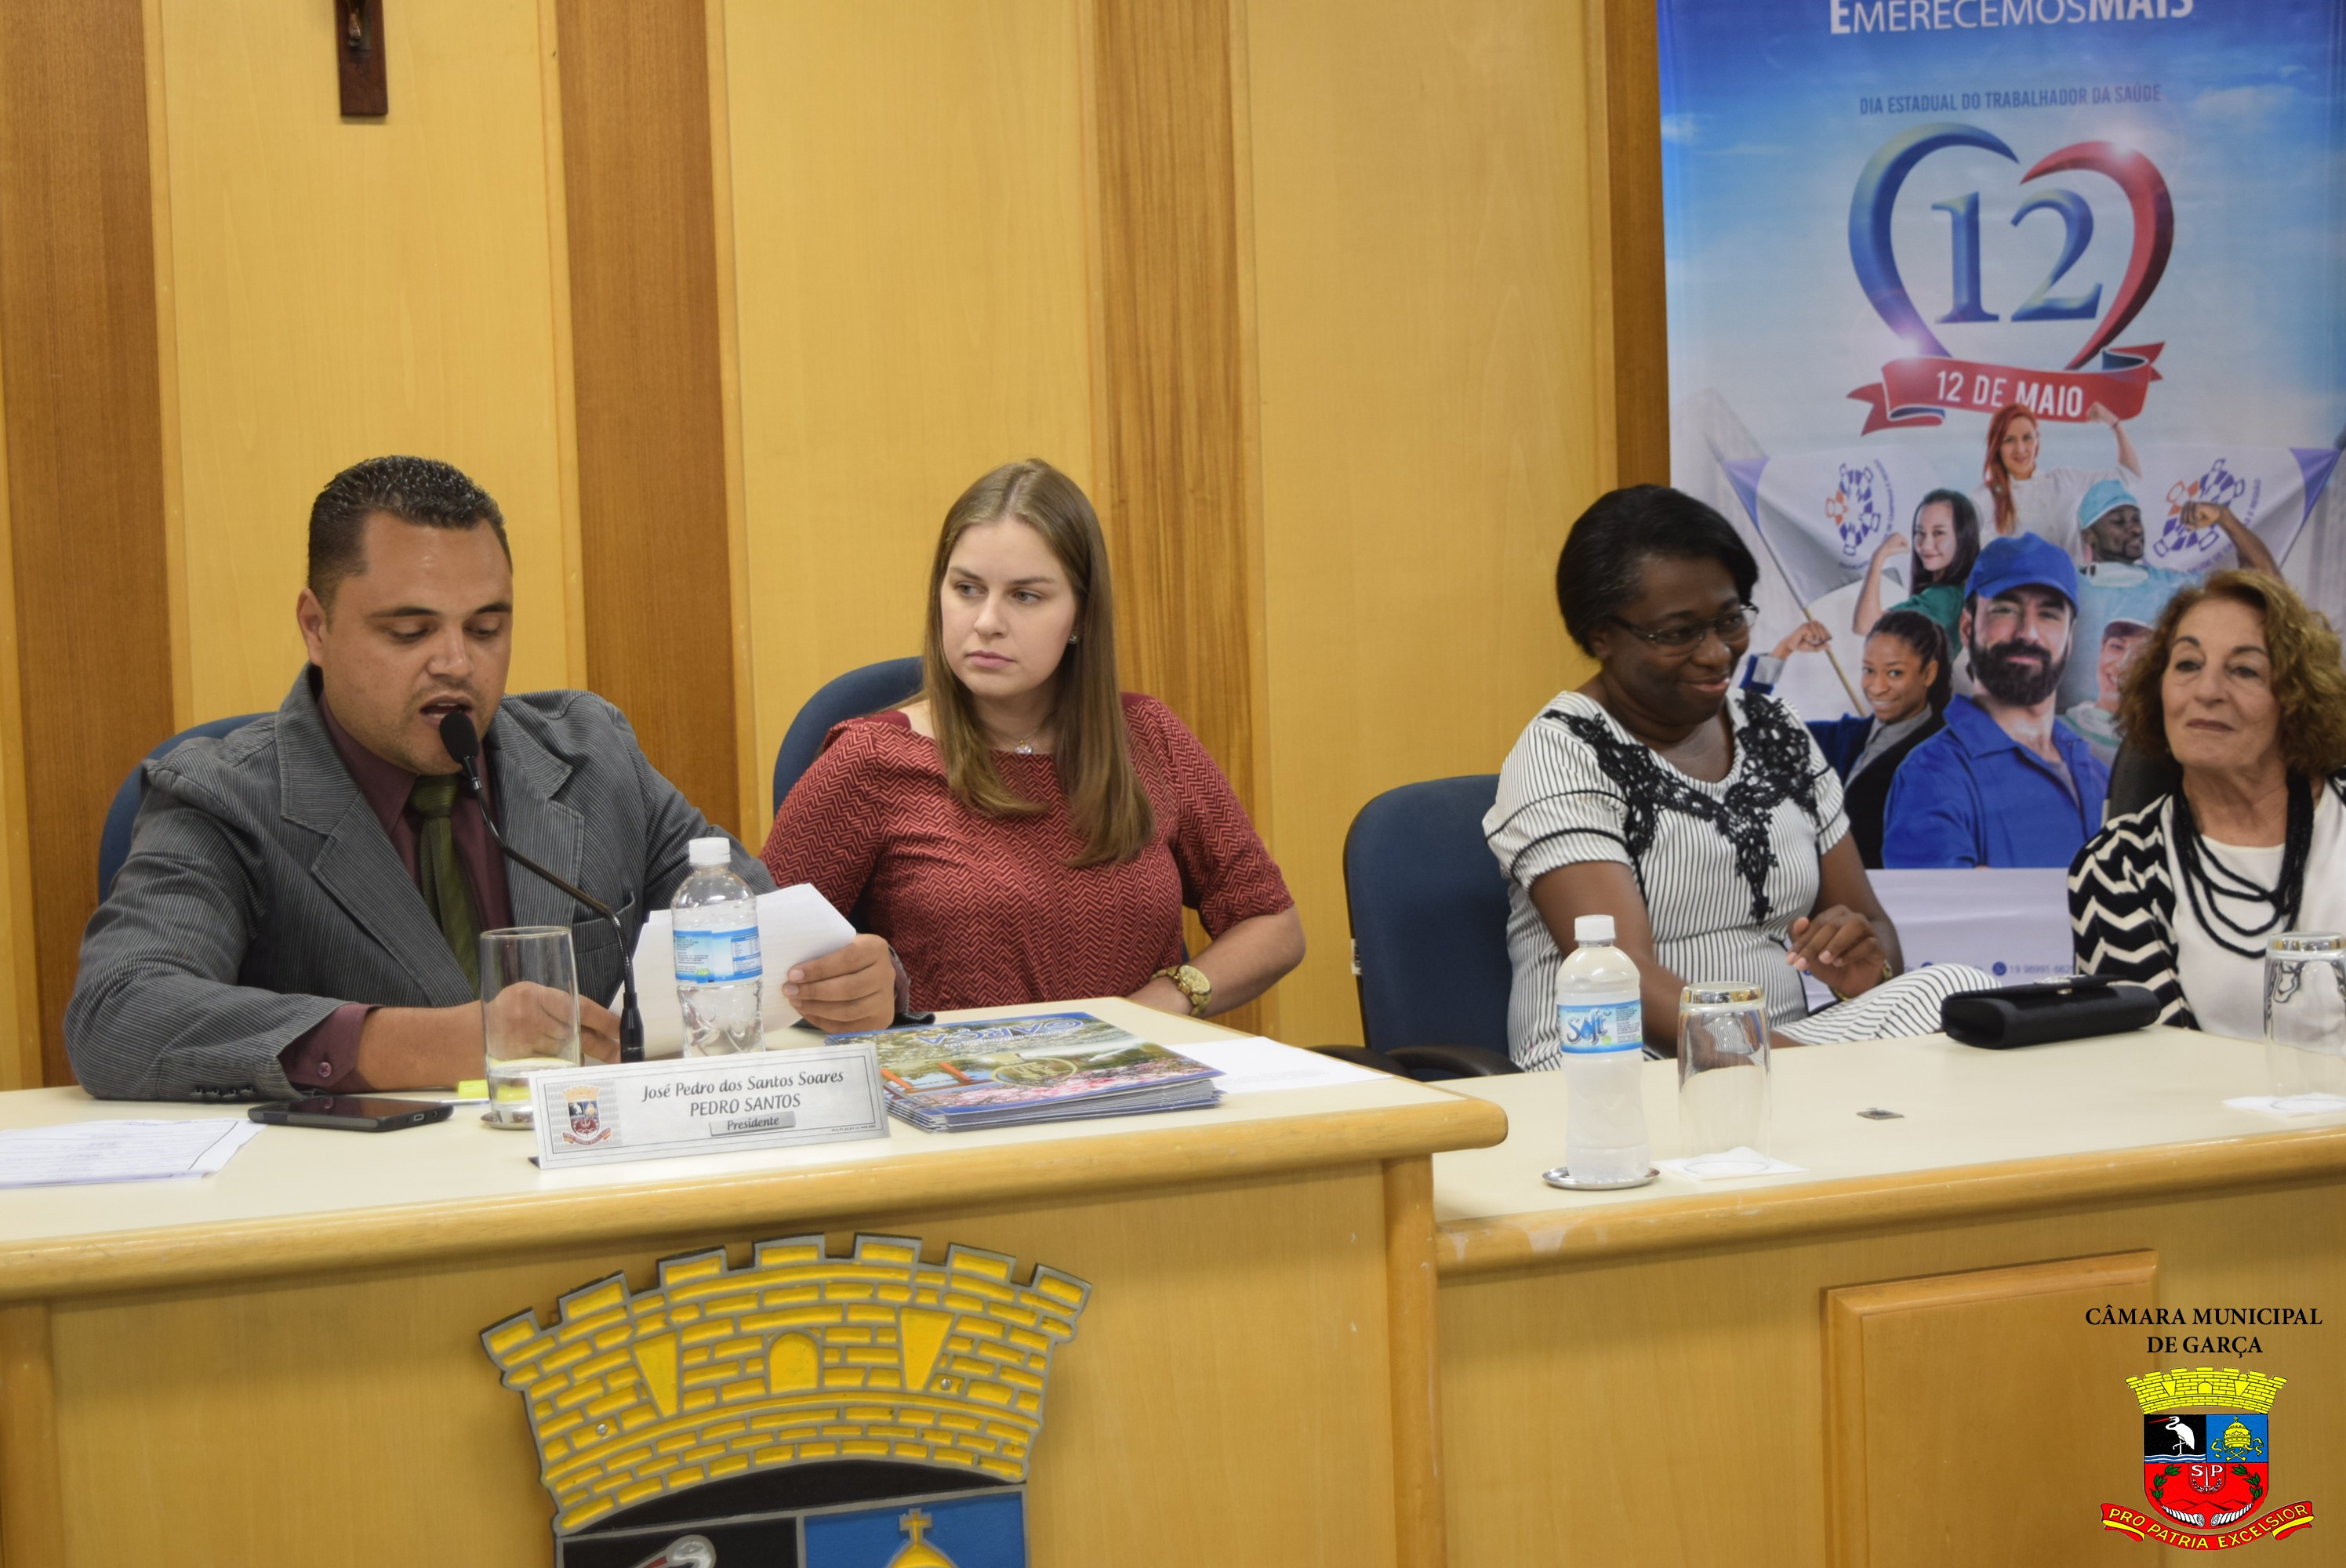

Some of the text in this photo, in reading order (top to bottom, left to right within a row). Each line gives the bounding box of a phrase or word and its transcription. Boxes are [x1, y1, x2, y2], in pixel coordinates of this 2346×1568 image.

[1860, 82, 2162, 115] DIA ESTADUAL DO TRABALHADOR DA SAÚDE
[1930, 188, 2103, 324] 12
[1937, 370, 2083, 418] 12 DE MAIO
[1567, 1008, 1607, 1045] Soft
[641, 1070, 844, 1102] José Pedro dos Santos Soares
[690, 1093, 801, 1117] PEDRO SANTOS
[726, 1116, 779, 1131] Presidente
